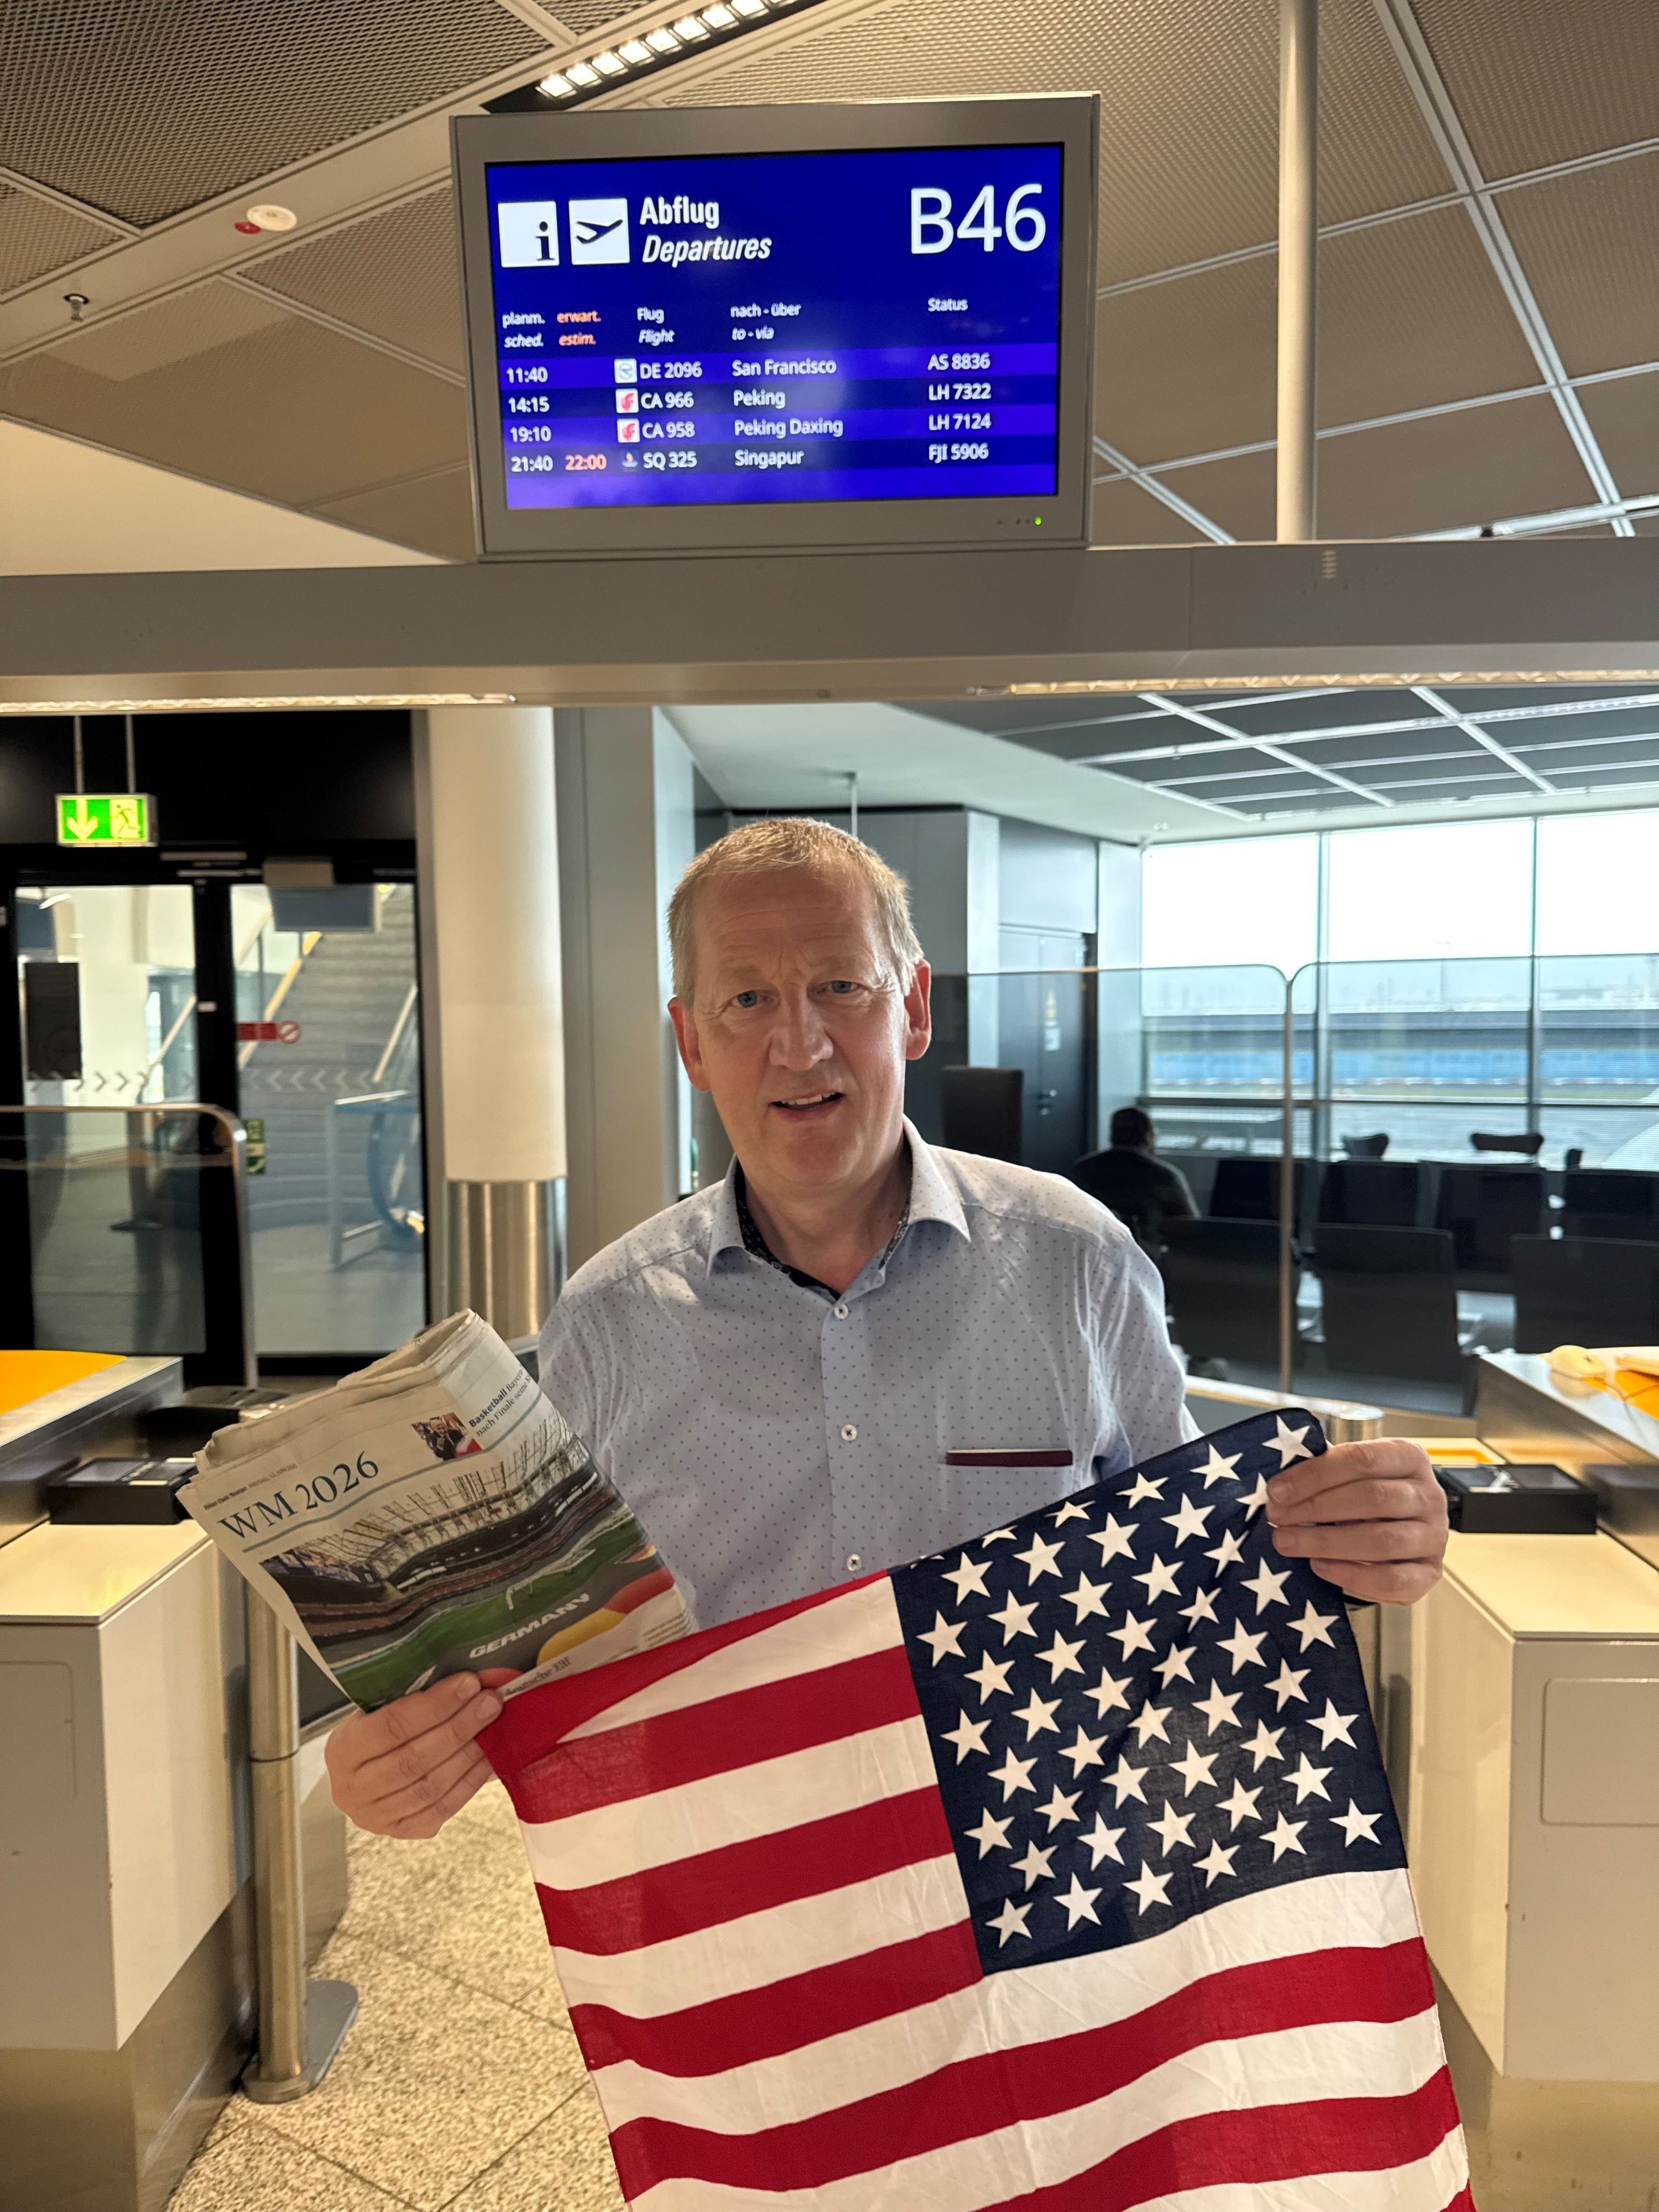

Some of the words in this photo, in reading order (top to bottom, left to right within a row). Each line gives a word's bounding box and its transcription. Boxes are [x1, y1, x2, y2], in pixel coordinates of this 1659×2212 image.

[639, 196, 719, 228] Abflug
[910, 183, 1046, 254] B46
[642, 234, 773, 268] Departures
[730, 303, 761, 317] nach
[771, 302, 801, 316] über
[927, 298, 968, 312] Status
[502, 311, 545, 328] planm.
[557, 310, 601, 323] erwart.
[637, 307, 664, 324] Flug
[504, 332, 544, 348] sched.
[559, 332, 596, 346] estim.
[639, 328, 675, 346] Flight
[732, 327, 746, 340] to
[755, 325, 774, 340] via
[640, 363, 661, 379] DE
[664, 361, 702, 378] 2096
[732, 359, 761, 376] San
[764, 357, 837, 375] Francisco
[927, 354, 949, 371] AS
[952, 352, 990, 369] 8836
[506, 367, 548, 383] 11:40
[641, 393, 663, 409] CA
[665, 392, 694, 408] 966
[733, 389, 785, 409] Peking
[929, 384, 950, 400] LH
[953, 383, 991, 400] 7322
[508, 397, 550, 413] 14:15
[642, 422, 665, 439] CA
[666, 421, 695, 437] 958
[734, 419, 786, 439] Peking
[790, 418, 843, 437] Daxing
[929, 414, 950, 431] LH
[953, 413, 992, 430] 7124
[510, 426, 551, 442] 19:10
[643, 452, 666, 471] SQ
[669, 451, 697, 468] 325
[734, 449, 805, 469] Singapur
[929, 444, 948, 463] FJI
[951, 442, 989, 460] 5906
[511, 455, 553, 472] 21:40
[565, 454, 607, 470] 22:00
[469, 1389, 508, 1427] Basketball
[476, 1418, 495, 1437] nach
[494, 1399, 515, 1420] Finale
[217, 1491, 299, 1538] WM
[295, 1451, 379, 1510] 2026
[469, 1593, 590, 1658] GERMANY
